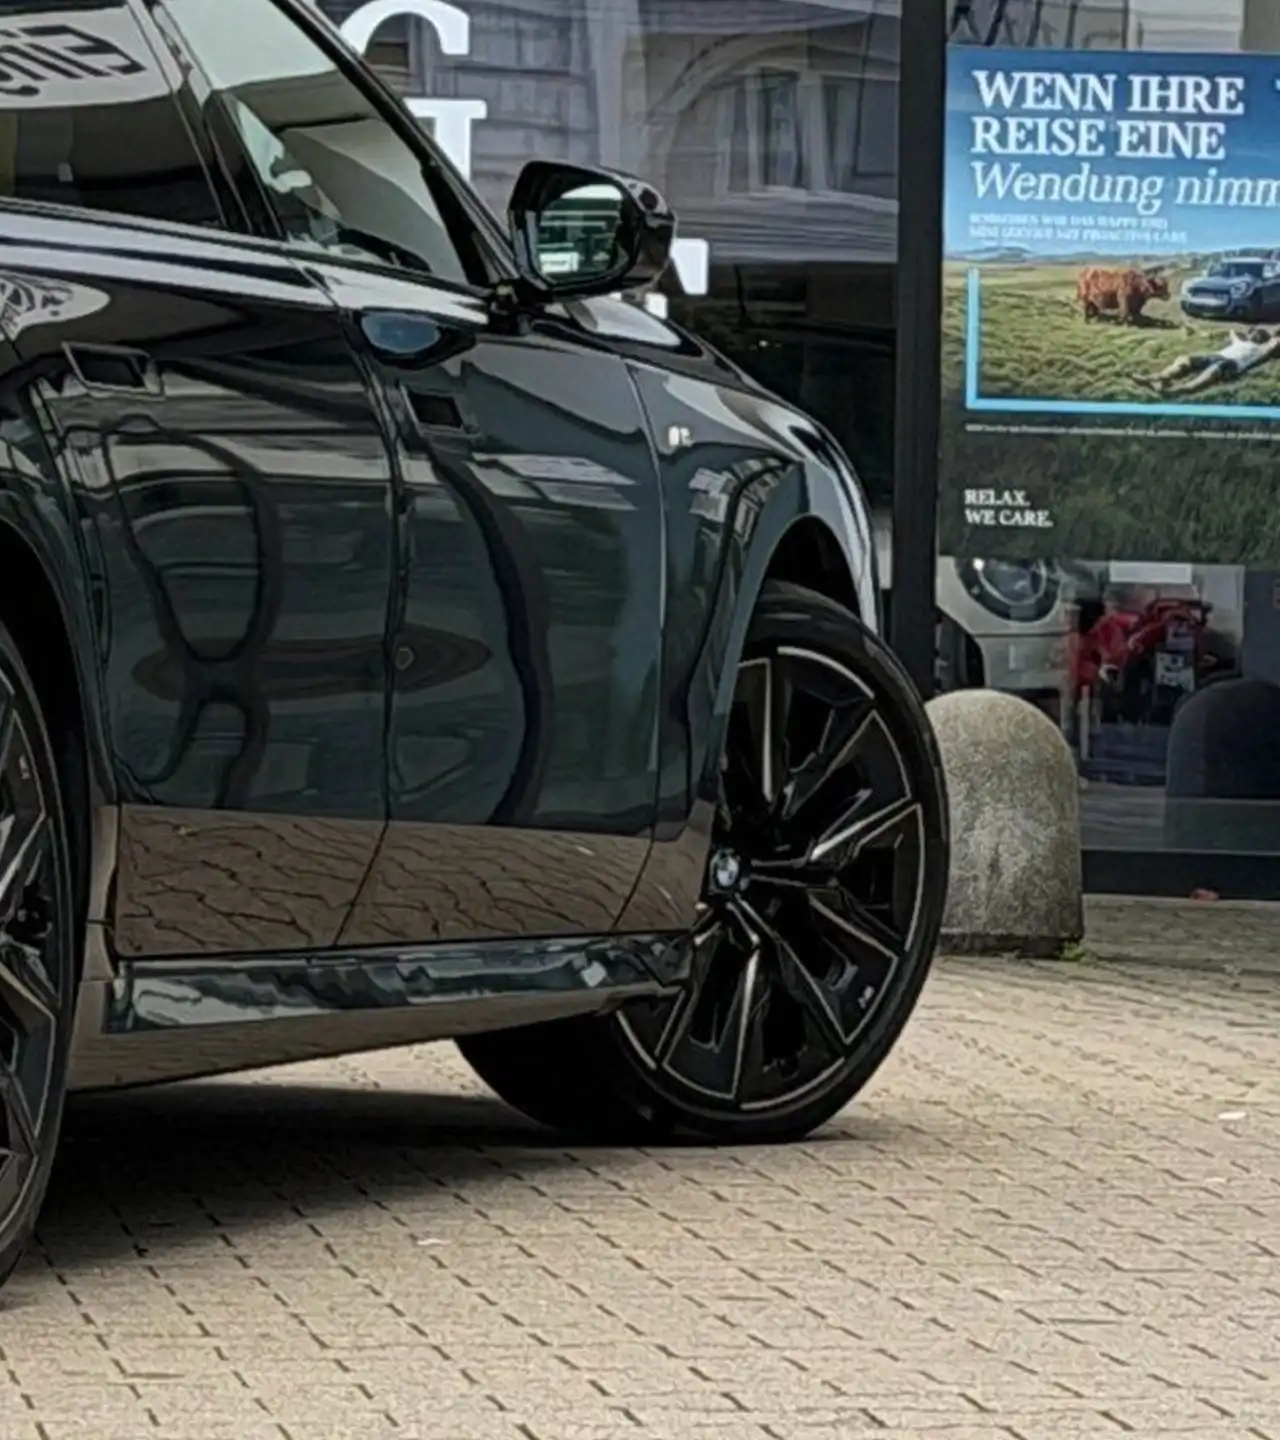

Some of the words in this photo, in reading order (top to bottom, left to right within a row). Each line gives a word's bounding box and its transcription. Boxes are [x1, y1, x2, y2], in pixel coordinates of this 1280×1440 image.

[971, 70, 1116, 112] WENN
[1127, 74, 1245, 115] IHRE
[970, 116, 1105, 157] REISE
[1115, 120, 1227, 160] EINE
[969, 160, 1165, 216] Wendung
[963, 487, 1032, 507] RELAX.
[963, 507, 997, 526] WE
[999, 508, 1055, 528] CARE.
